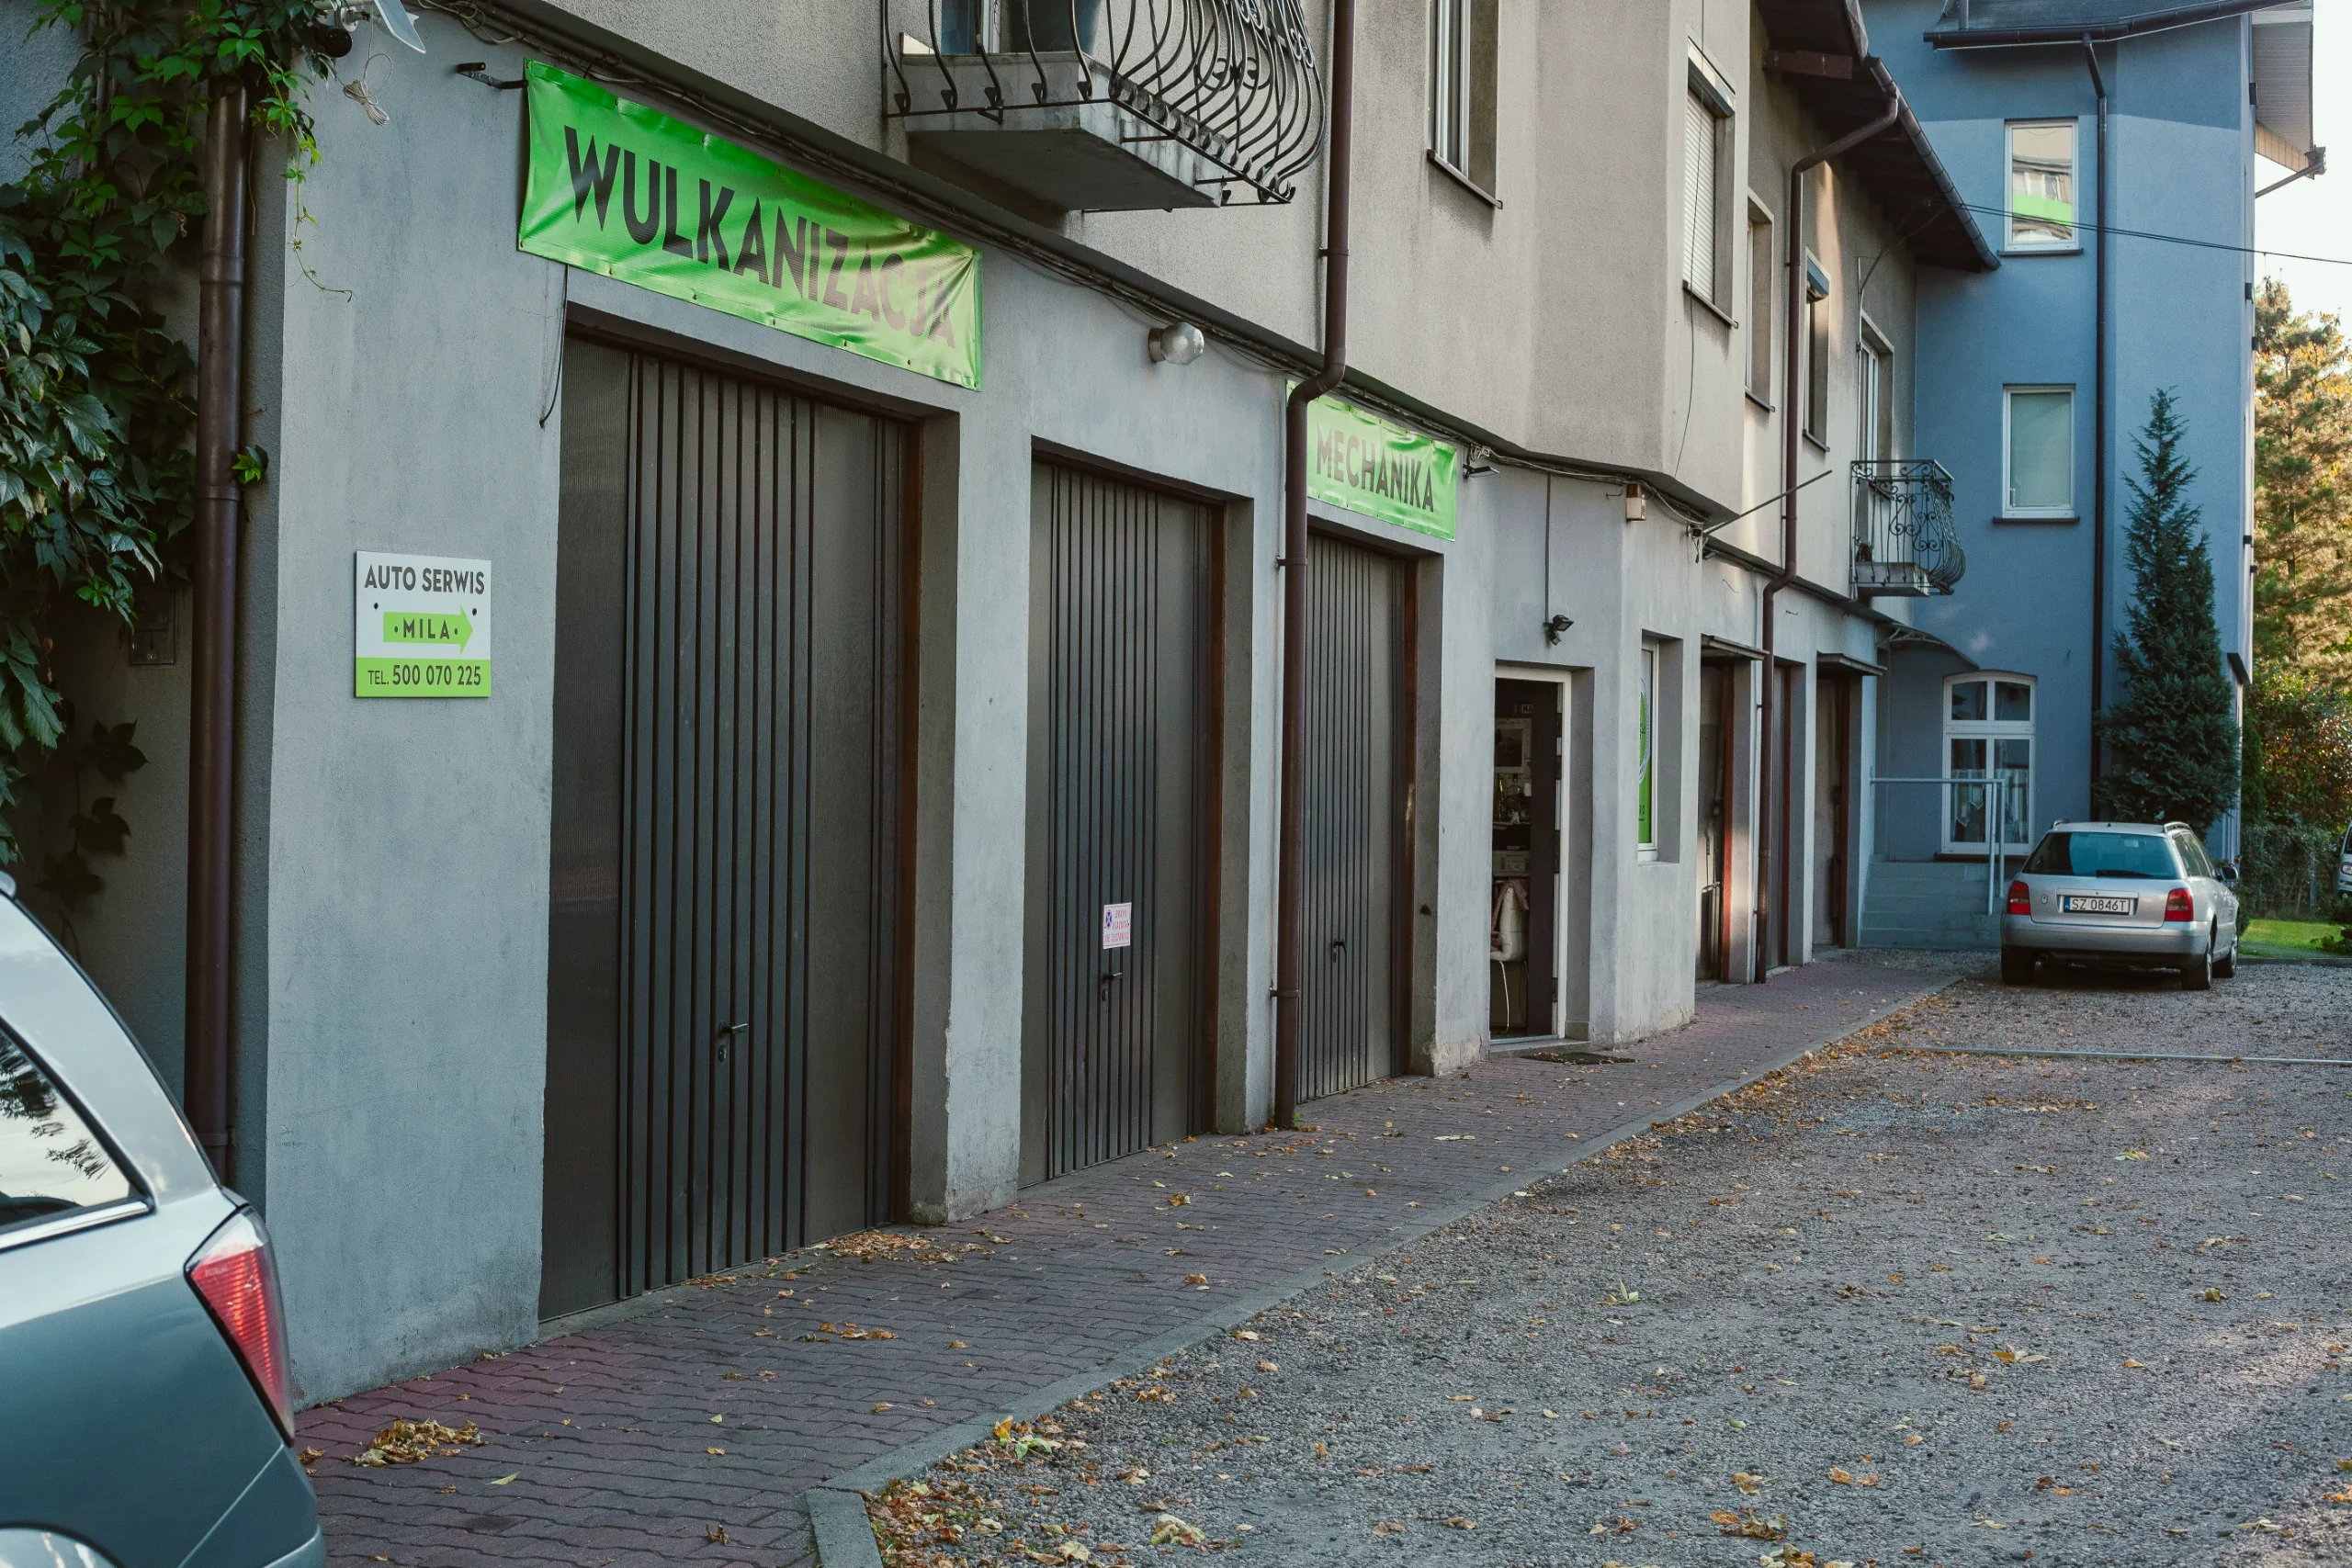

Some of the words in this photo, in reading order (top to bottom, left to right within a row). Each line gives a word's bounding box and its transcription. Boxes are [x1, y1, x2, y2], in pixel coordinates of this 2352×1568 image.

[563, 125, 956, 349] WULKANIZACJA
[1316, 421, 1435, 513] MECHANIKA
[364, 564, 416, 592] AUTO
[421, 567, 486, 595] SERWIS
[402, 617, 450, 639] MILA
[368, 670, 390, 685] TEL.
[392, 664, 421, 685] 500
[425, 665, 453, 686] 070
[457, 665, 482, 686] 225
[2072, 898, 2087, 910] SZ
[2090, 899, 2127, 911] 0846T
